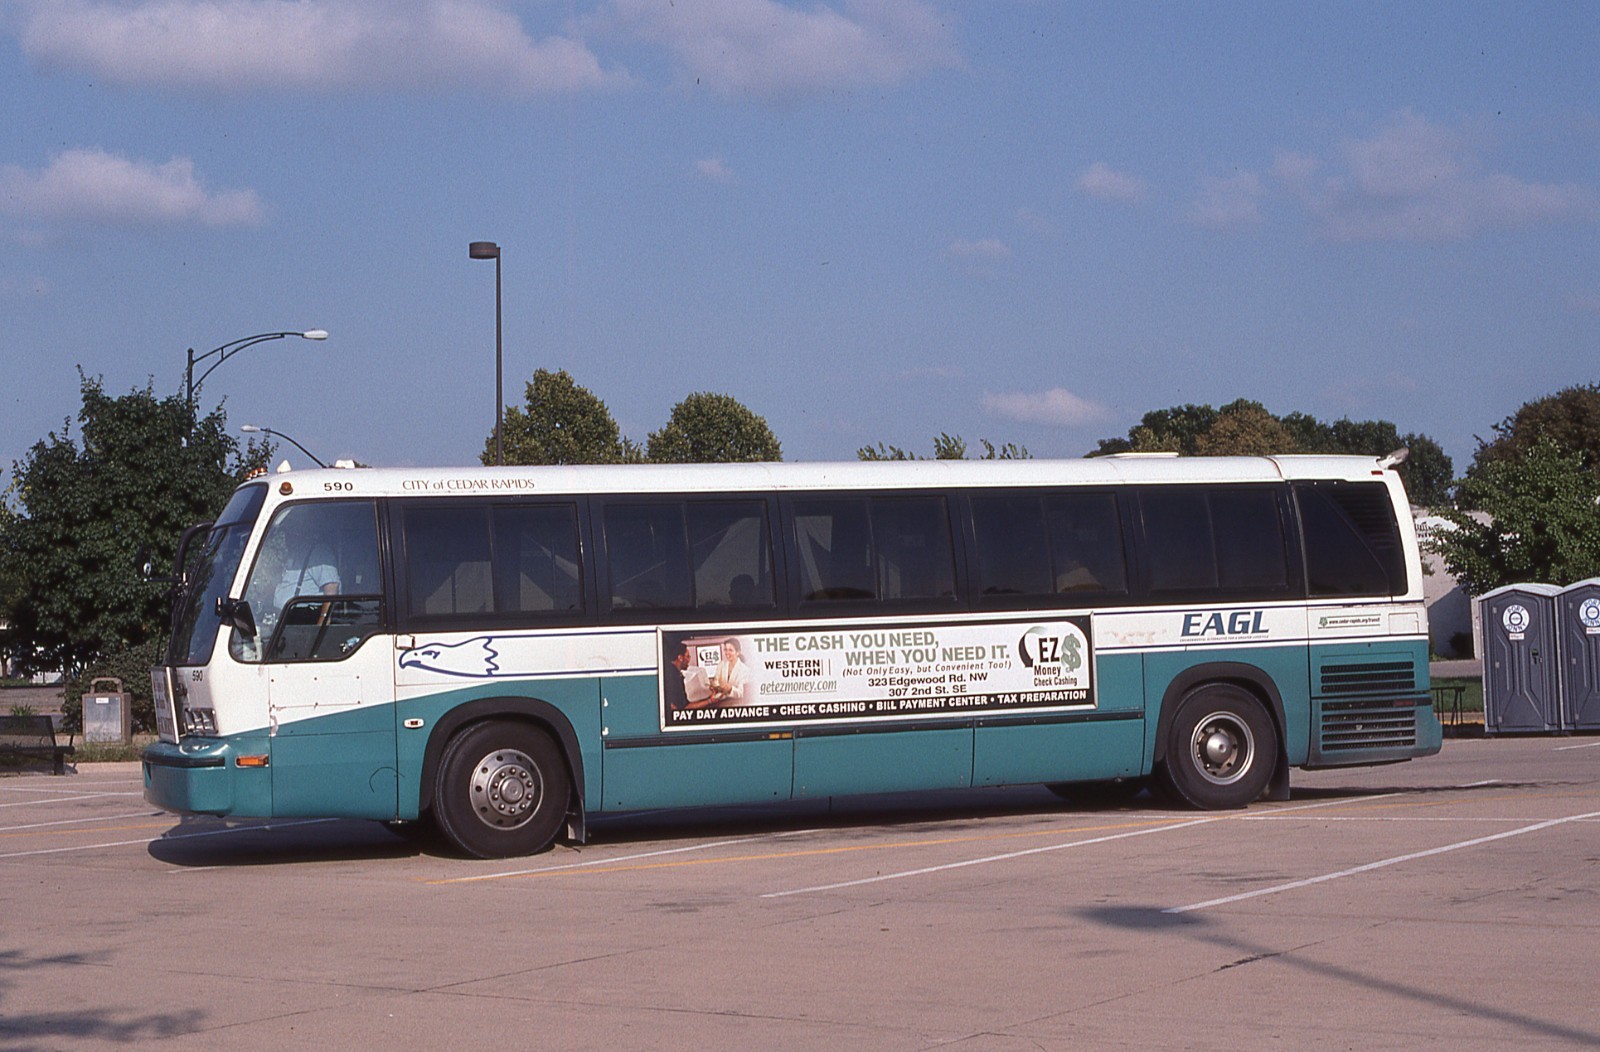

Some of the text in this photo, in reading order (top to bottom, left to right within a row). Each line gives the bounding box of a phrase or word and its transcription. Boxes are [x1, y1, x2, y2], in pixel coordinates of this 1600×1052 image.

[324, 482, 354, 492] 590
[402, 478, 535, 490] CITY of CEDAR RAPIDS
[1181, 611, 1269, 636] EAGL
[754, 632, 939, 652] THE CASH YOU NEED,
[845, 645, 1010, 666] WHEN YOU NEED IT.
[1038, 636, 1060, 663] EZ
[764, 660, 820, 670] WESTERN
[842, 660, 1012, 678] (Not Only Easy, but Convenient Too!)
[1034, 664, 1061, 678] Money
[192, 670, 203, 681] 590
[782, 668, 820, 678] UNION
[868, 672, 988, 687] 323 Edgewood Rd. NW
[760, 679, 837, 695] getezmoney.com
[1034, 676, 1078, 687] Check Cashing
[888, 684, 967, 697] 307 2nd St. SE
[673, 690, 1086, 721] PAY DAY ADVANCE CHECK CASHING BILL PAYMENT CENTER TAX PREPARATION
